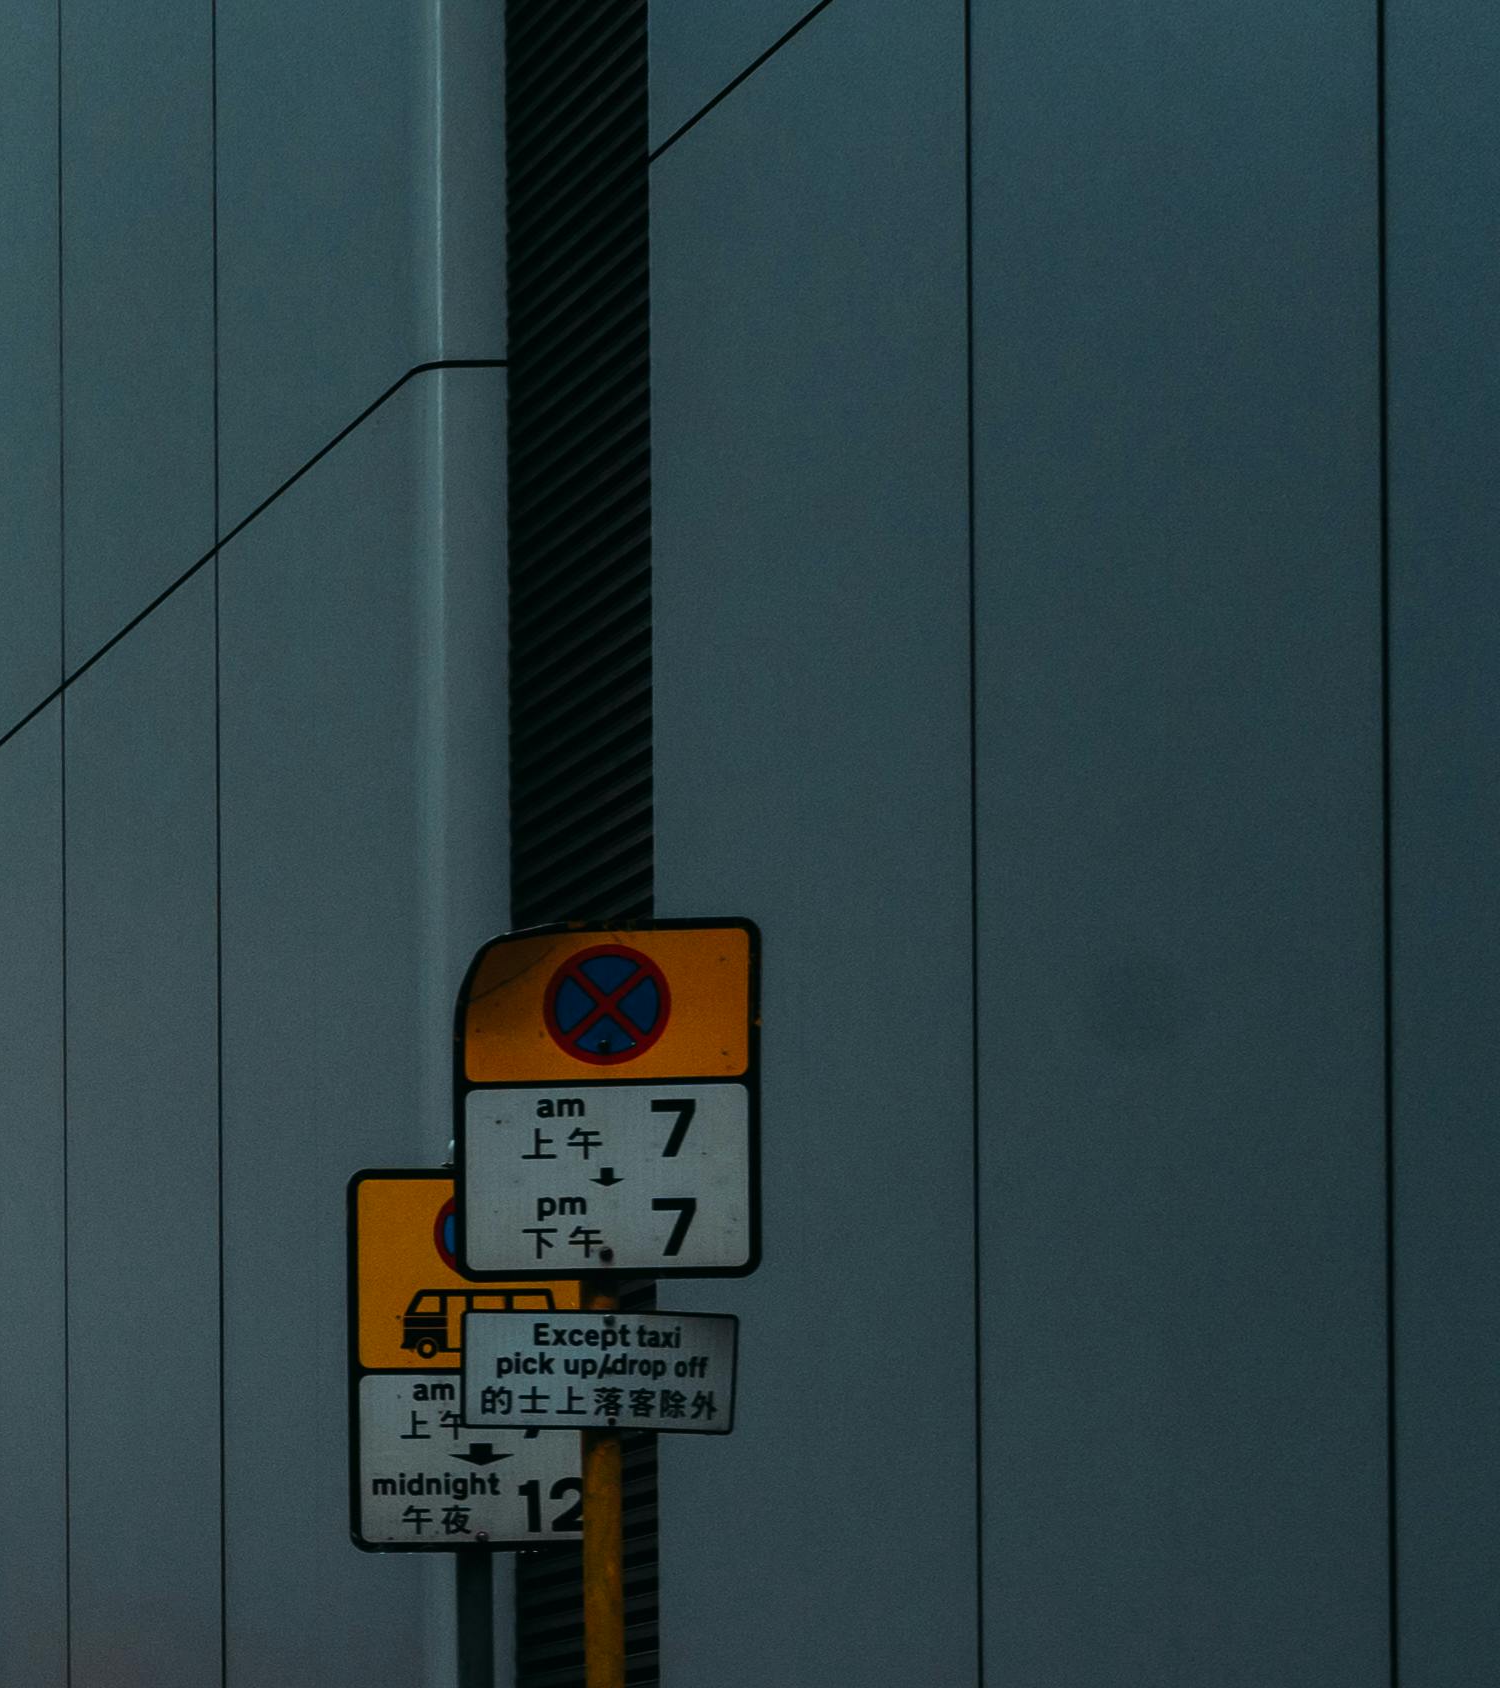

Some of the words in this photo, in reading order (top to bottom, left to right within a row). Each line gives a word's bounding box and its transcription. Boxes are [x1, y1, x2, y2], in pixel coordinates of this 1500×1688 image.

[536, 1098, 585, 1118] am
[521, 1127, 603, 1160] 上午
[650, 1098, 697, 1158] 7
[537, 1195, 587, 1221] pm
[521, 1225, 604, 1260] 下午
[651, 1197, 697, 1257] 7
[533, 1323, 631, 1350] Except
[637, 1325, 682, 1349] taxi
[496, 1351, 555, 1379] pick
[563, 1353, 667, 1380] up/drop
[674, 1356, 710, 1379] off
[413, 1382, 455, 1402] am
[480, 1385, 718, 1421] 的士上落客除外
[400, 1410, 461, 1441] 上午
[371, 1472, 501, 1501] midnight
[402, 1504, 472, 1536] 午夜
[517, 1476, 584, 1534] 12
